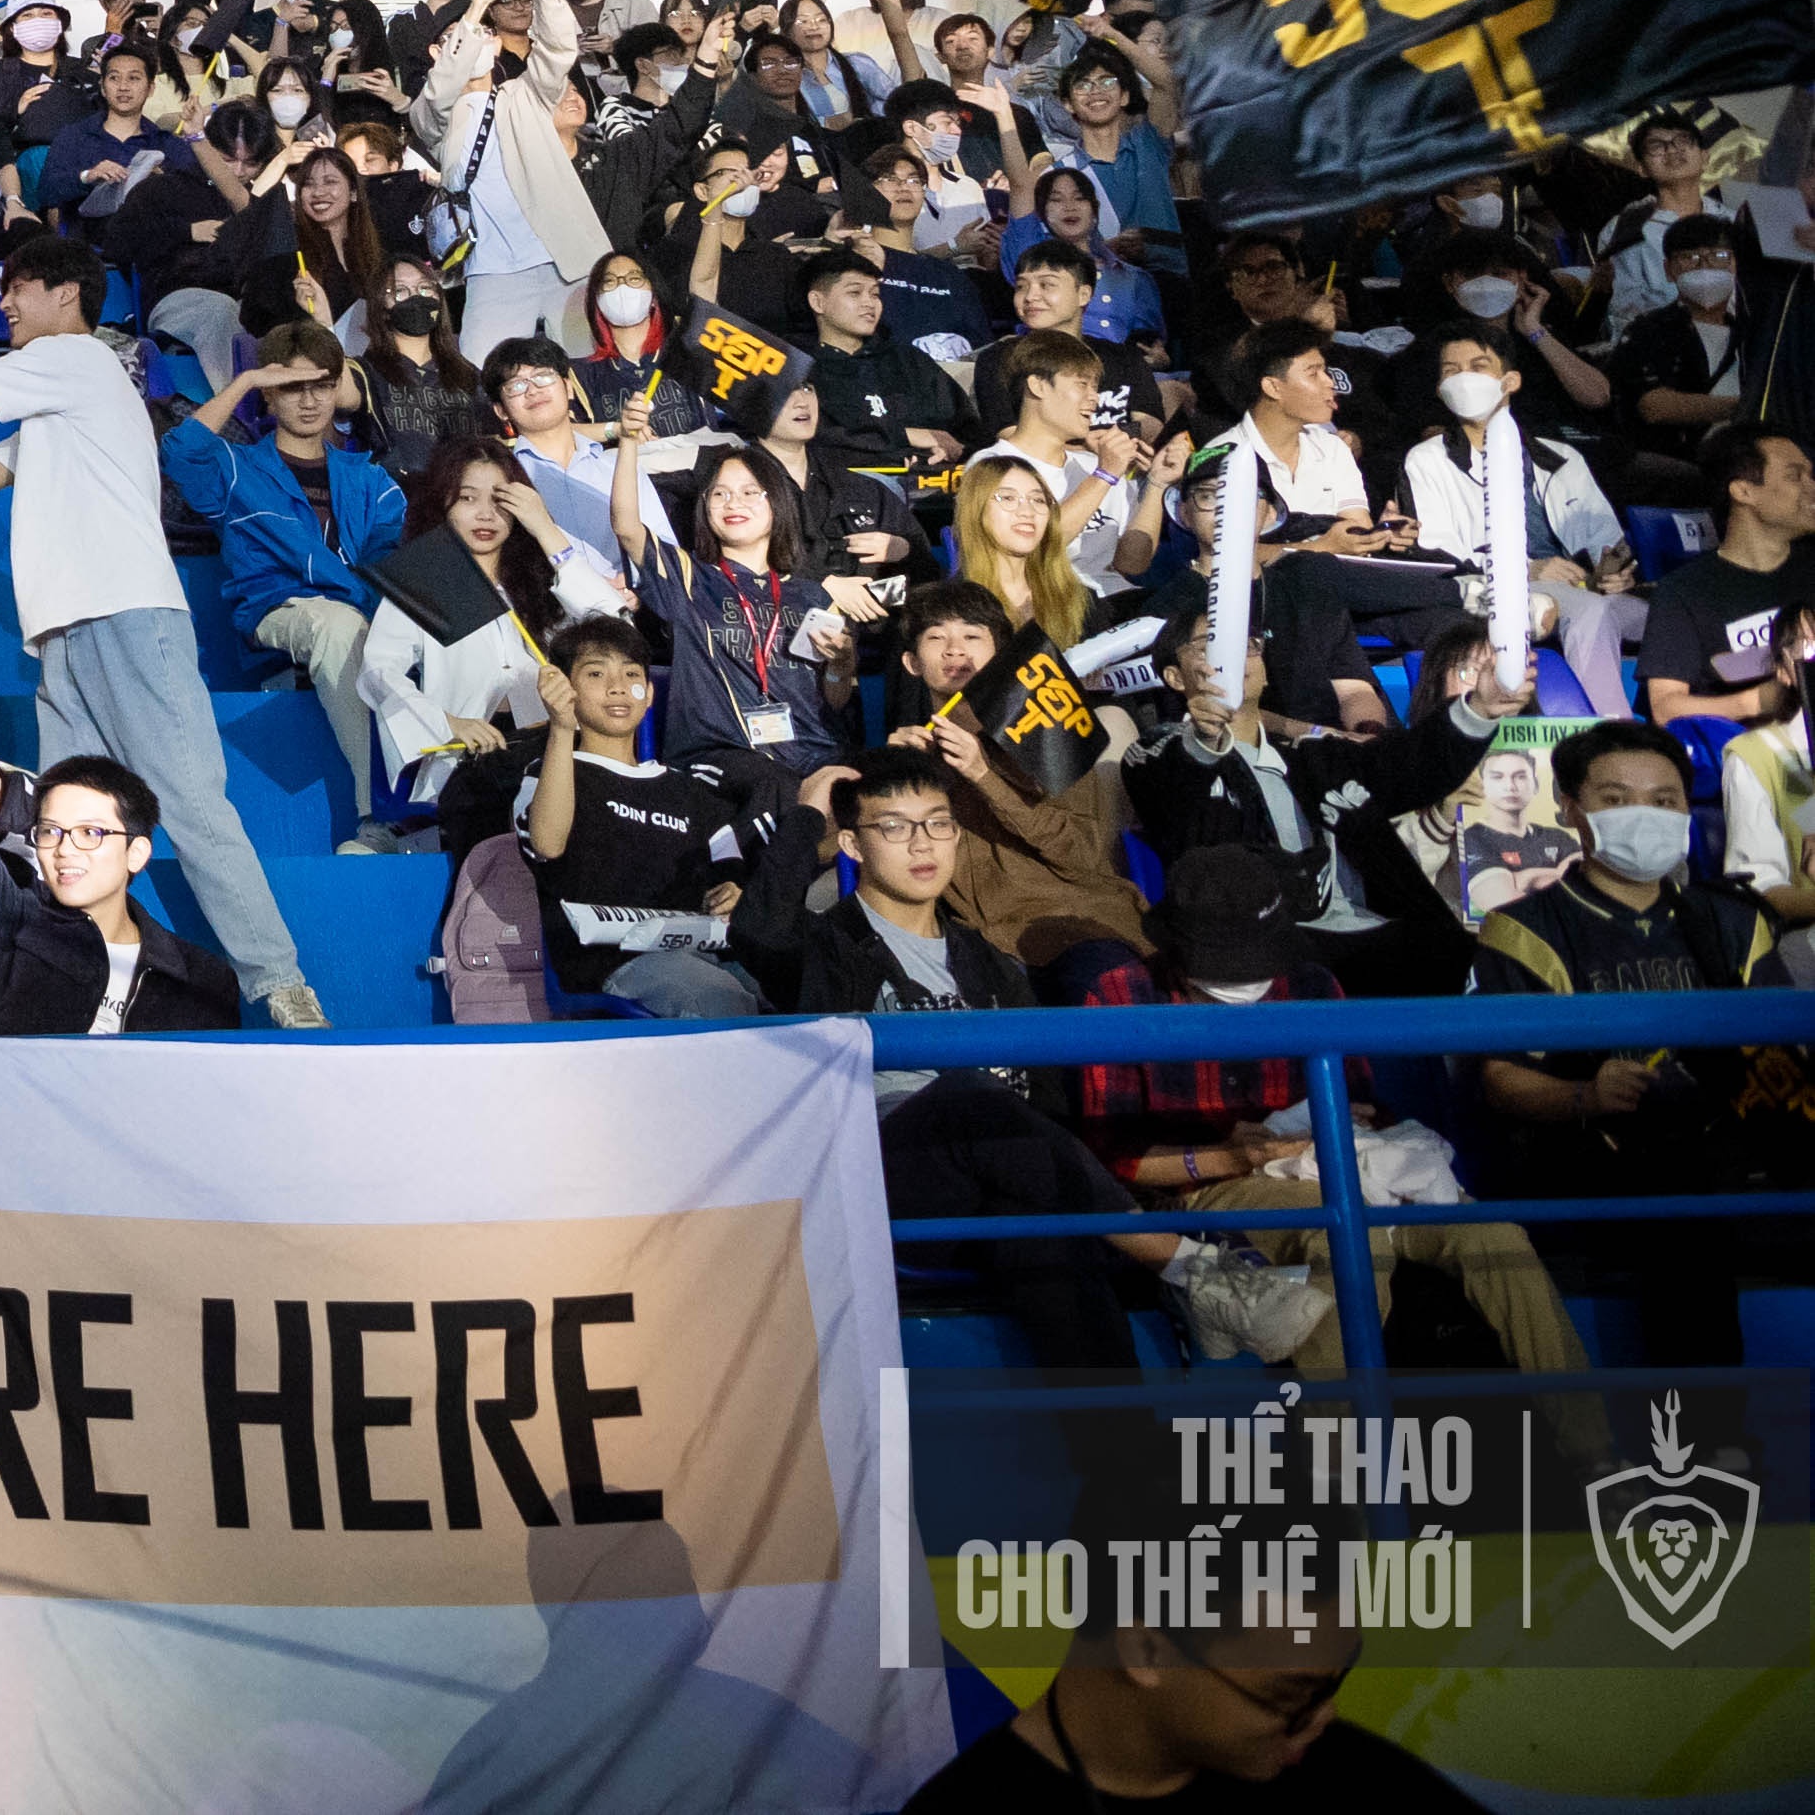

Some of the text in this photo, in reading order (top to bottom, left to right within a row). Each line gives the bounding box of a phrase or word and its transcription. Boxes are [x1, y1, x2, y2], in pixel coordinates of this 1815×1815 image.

[698, 317, 787, 376] SGP
[1016, 653, 1094, 737] SGP
[1503, 725, 1537, 743] FISH
[1542, 725, 1569, 743] TAY
[651, 812, 688, 833] CLUB
[659, 933, 693, 952] SGP
[201, 1292, 665, 1532] HERE
